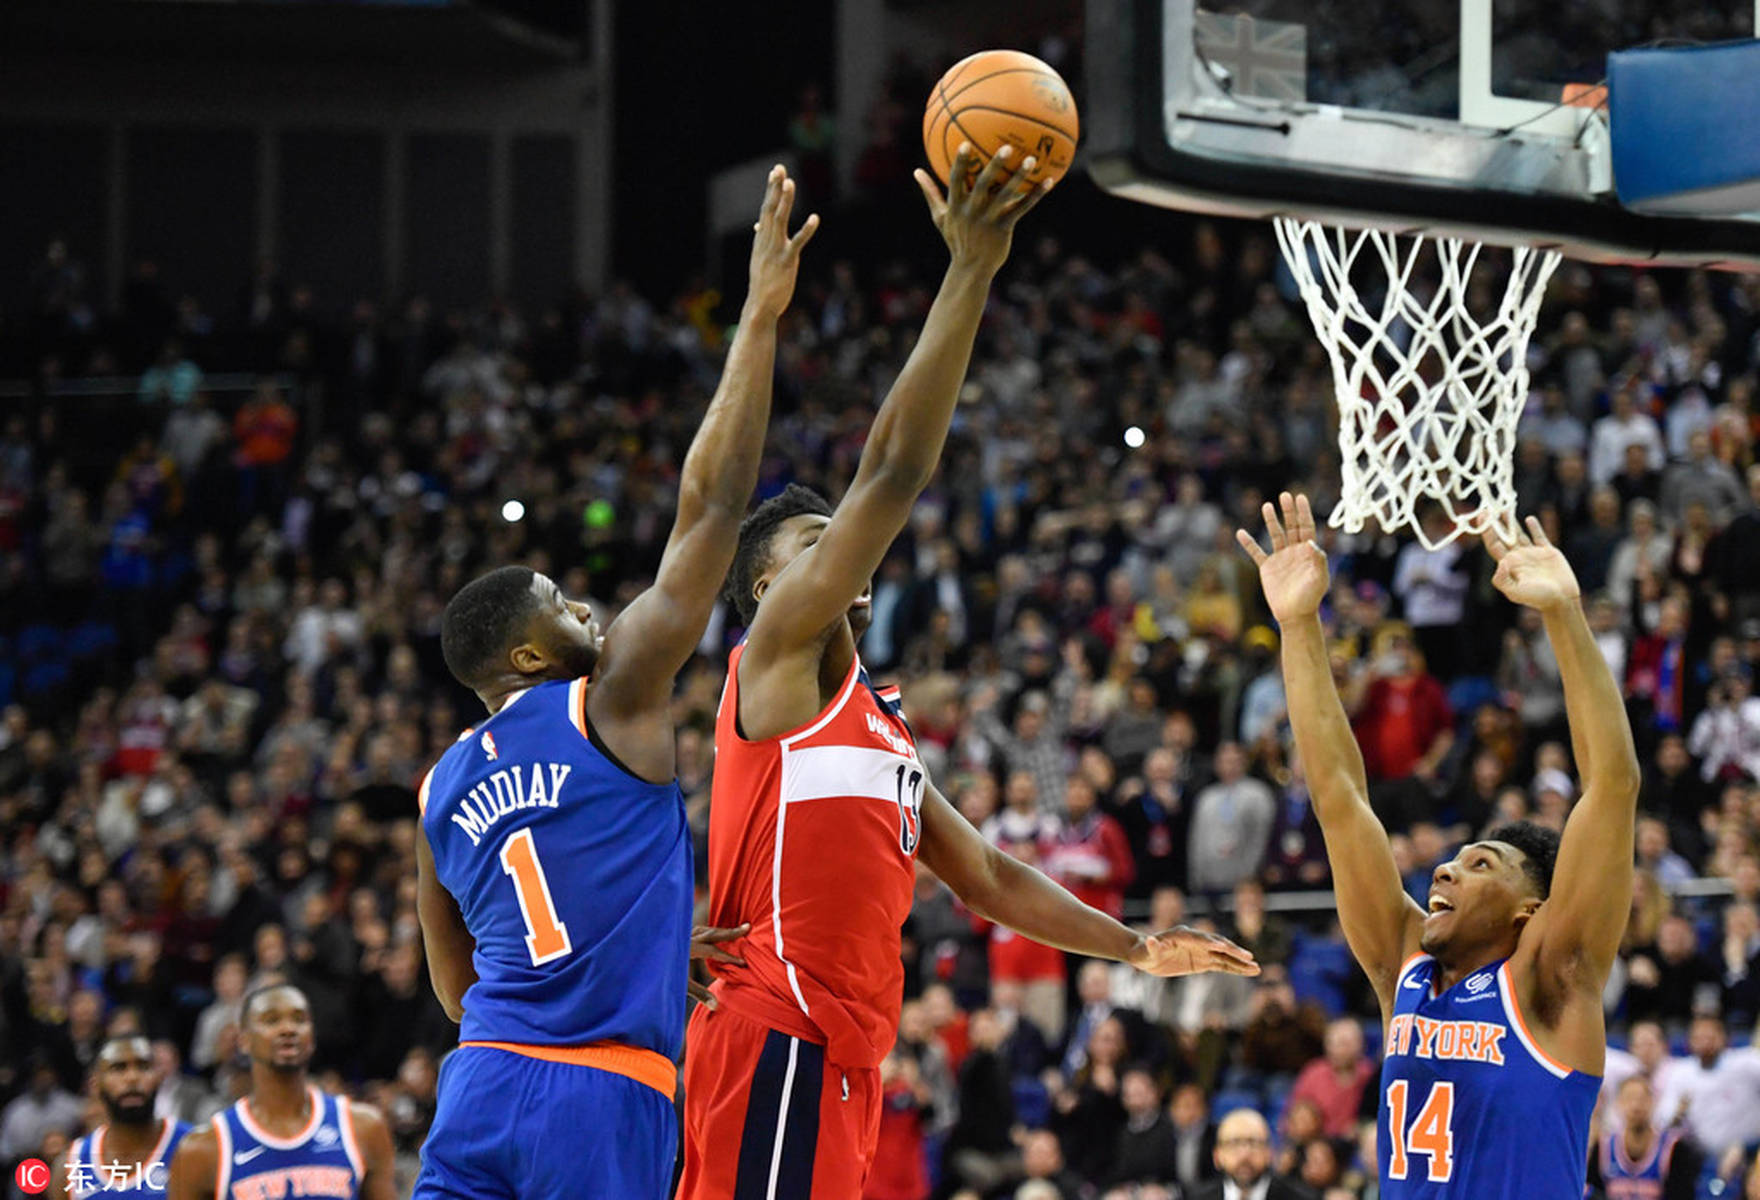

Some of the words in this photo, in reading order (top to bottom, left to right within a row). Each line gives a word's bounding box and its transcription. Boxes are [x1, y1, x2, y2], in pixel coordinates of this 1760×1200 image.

[451, 762, 571, 846] MUDIAY
[499, 827, 573, 967] 1
[1385, 1013, 1415, 1058] EW
[1415, 1014, 1506, 1067] YORK
[1386, 1079, 1454, 1183] 14
